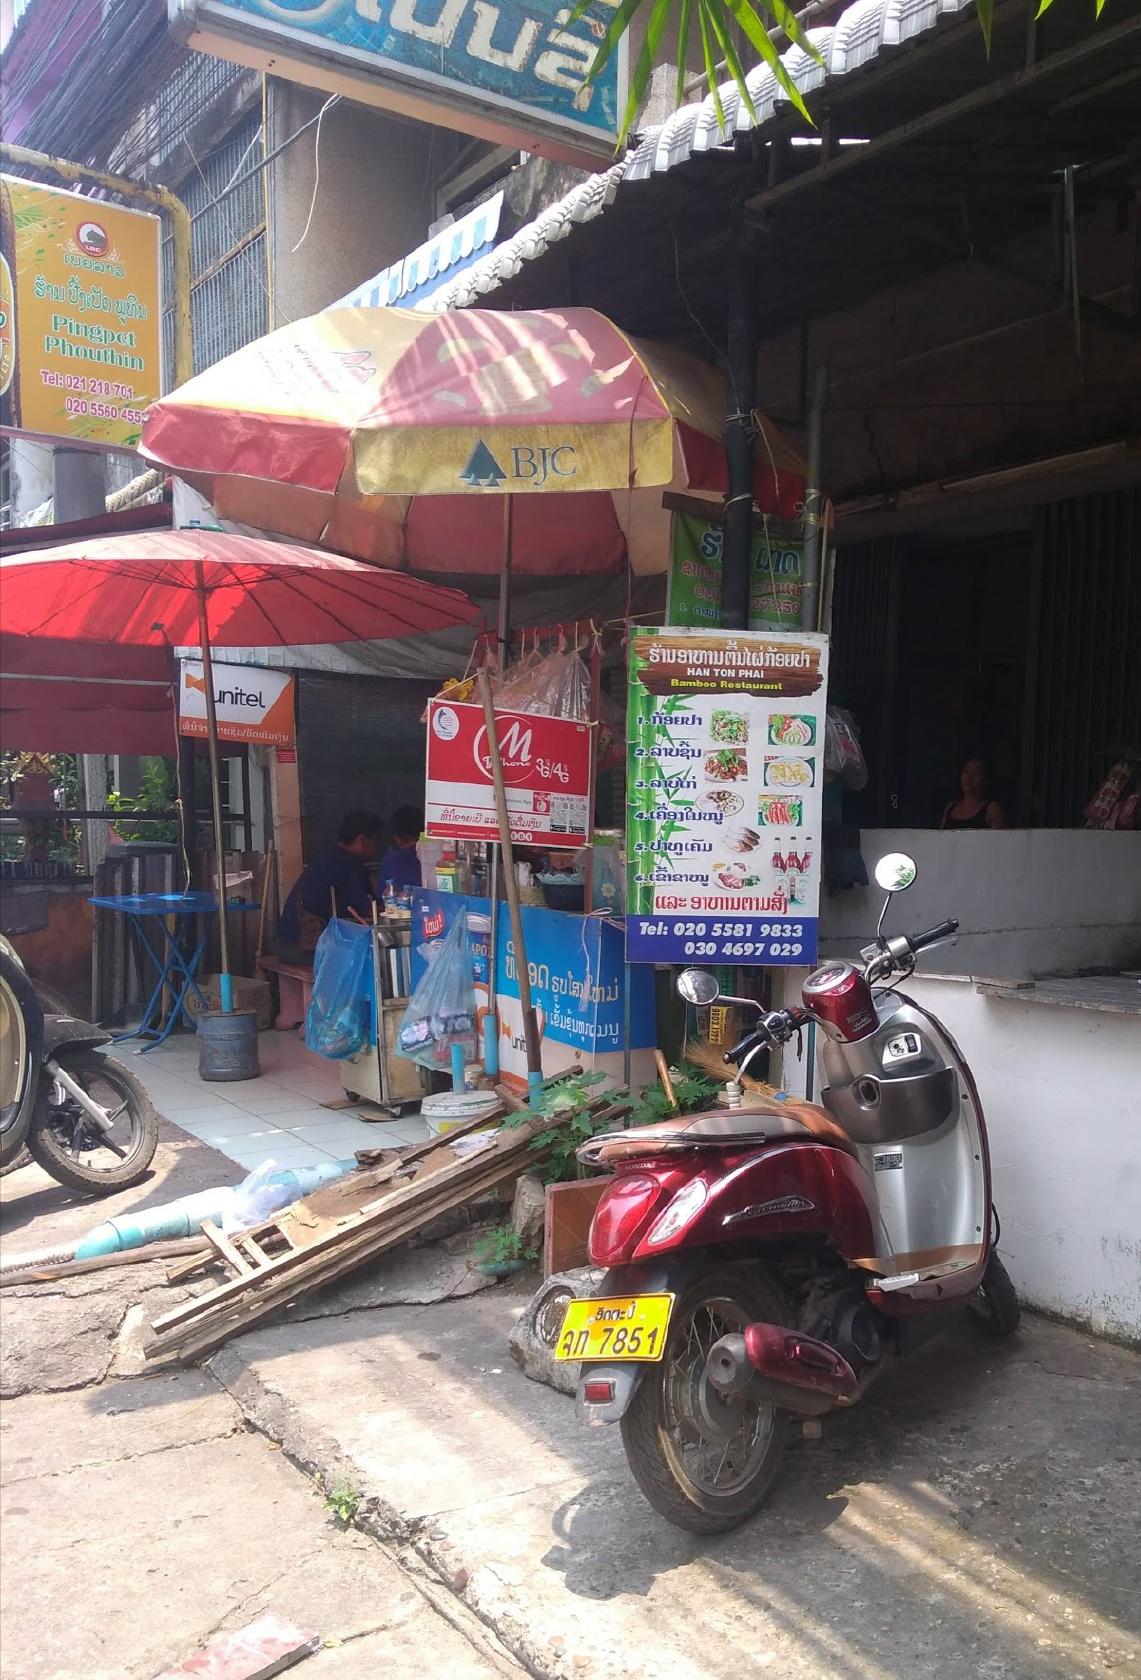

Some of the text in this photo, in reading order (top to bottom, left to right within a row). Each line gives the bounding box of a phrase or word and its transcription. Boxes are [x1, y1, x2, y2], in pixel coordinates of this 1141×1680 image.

[53, 314, 136, 347] Pingpet
[45, 336, 145, 371] Phouthin
[40, 369, 134, 399] Tel: 021 218 701
[66, 398, 87, 413] 020
[90, 403, 119, 420] 5560
[511, 446, 577, 486] BJC
[687, 668, 764, 678] HAN TON PHAI
[671, 679, 783, 690] Bamboo Restaurant
[214, 687, 266, 708] unitel
[639, 922, 803, 937] Tel: 020 5581 9833
[685, 942, 803, 956] 030 4697 029
[599, 1327, 658, 1355] 7851
